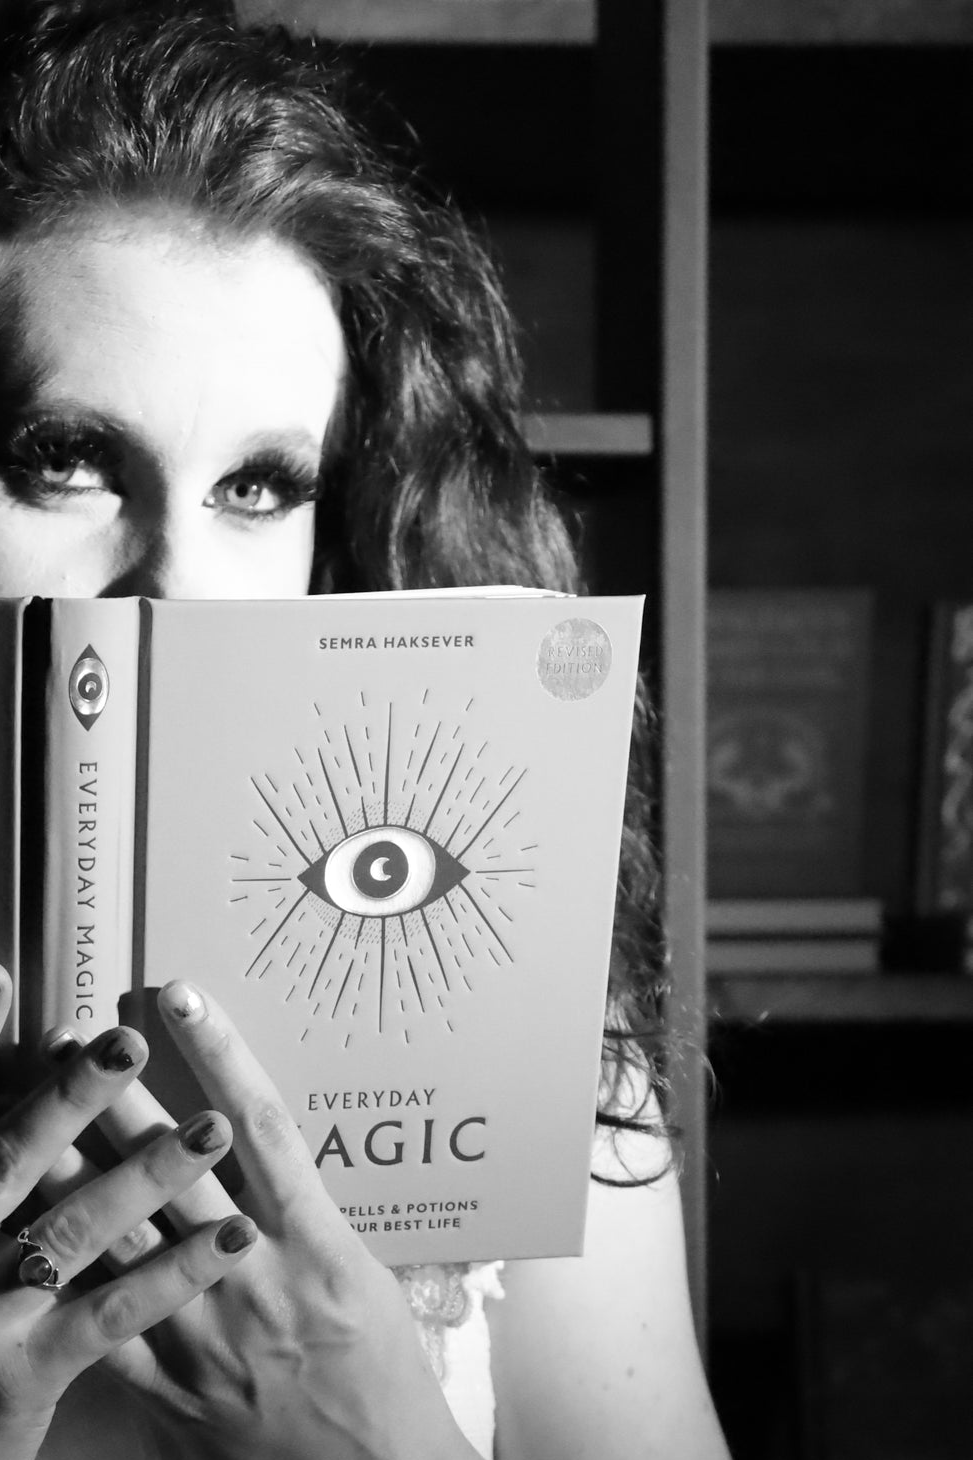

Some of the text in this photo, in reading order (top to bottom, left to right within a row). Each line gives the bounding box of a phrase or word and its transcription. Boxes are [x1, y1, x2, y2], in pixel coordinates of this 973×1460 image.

[319, 635, 474, 650] SEMRA HAKSEVER
[547, 645, 604, 657] REVISED
[546, 662, 603, 674] EDITION
[75, 761, 98, 1020] EVERYDAY MAGIC
[308, 1088, 435, 1111] EVERYDAY
[314, 1116, 487, 1168] AGIC
[339, 1201, 479, 1217] PELLS & POTIONS
[384, 1220, 422, 1232] BEST
[428, 1218, 461, 1229] LIFE
